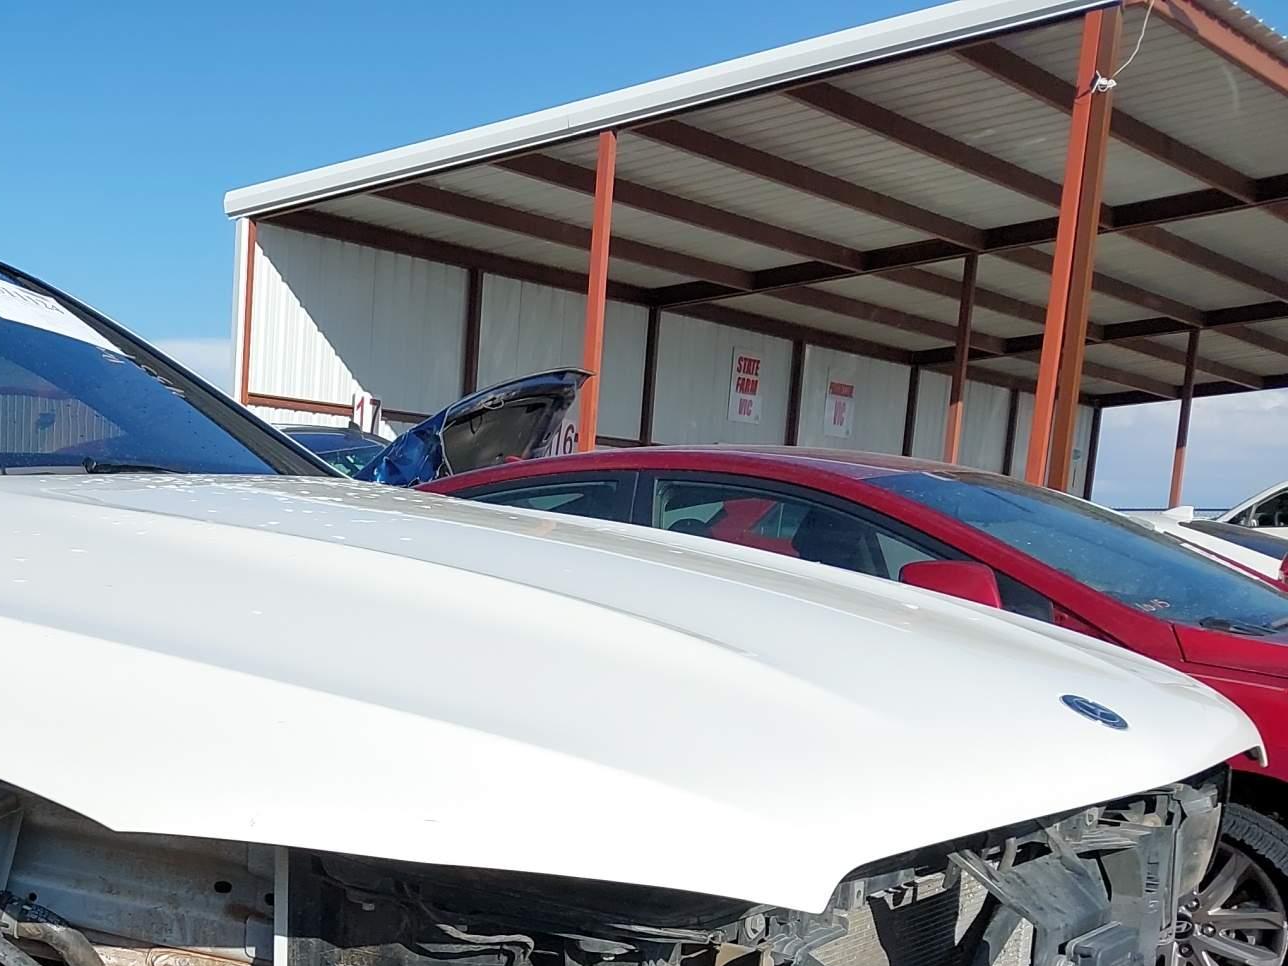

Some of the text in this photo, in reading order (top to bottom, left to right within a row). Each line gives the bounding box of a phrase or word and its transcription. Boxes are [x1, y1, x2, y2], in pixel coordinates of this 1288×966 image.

[737, 356, 760, 376] STATE
[736, 377, 758, 395] FARM
[356, 396, 381, 434] 17
[738, 398, 753, 416] VIC
